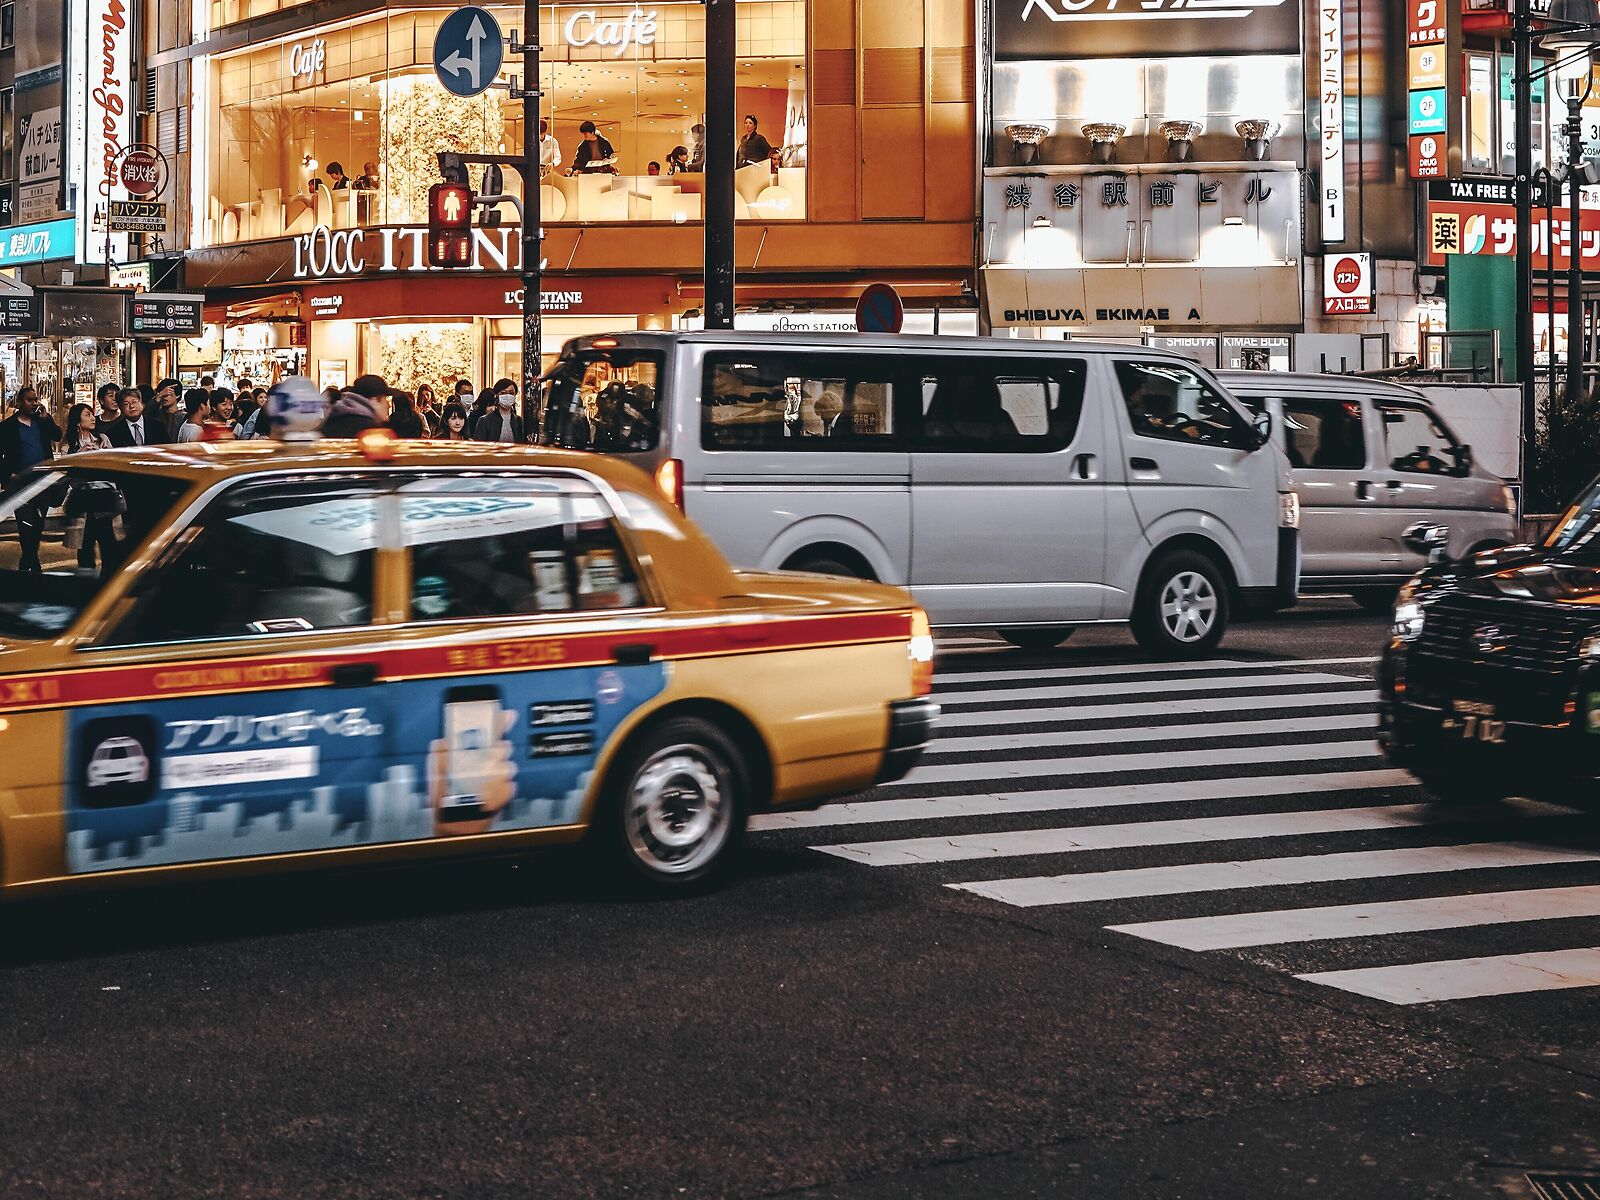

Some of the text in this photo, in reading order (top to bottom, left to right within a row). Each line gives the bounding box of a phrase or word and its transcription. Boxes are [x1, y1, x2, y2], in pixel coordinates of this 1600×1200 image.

[564, 7, 658, 55] Café
[288, 38, 326, 84] Café
[1422, 56, 1433, 67] 3F
[1323, 7, 1340, 161] マイアミガーデン
[1422, 100, 1433, 112] 2F
[1423, 142, 1433, 154] 1F
[1419, 158, 1437, 167] DRUG
[124, 164, 157, 182] 消火栓
[1418, 167, 1438, 176] STORE
[1005, 179, 1273, 209] 渋谷駅前ビル
[1450, 182, 1474, 197] TAX
[1476, 184, 1507, 199] FREE
[119, 203, 160, 217] パソコン
[1434, 216, 1457, 250] 薬
[1337, 272, 1359, 284] ガスト
[1335, 299, 1354, 311] 入口
[1003, 309, 1085, 322] SHIBUYA
[1095, 308, 1170, 321] EKIMAE
[813, 323, 857, 332] STATION
